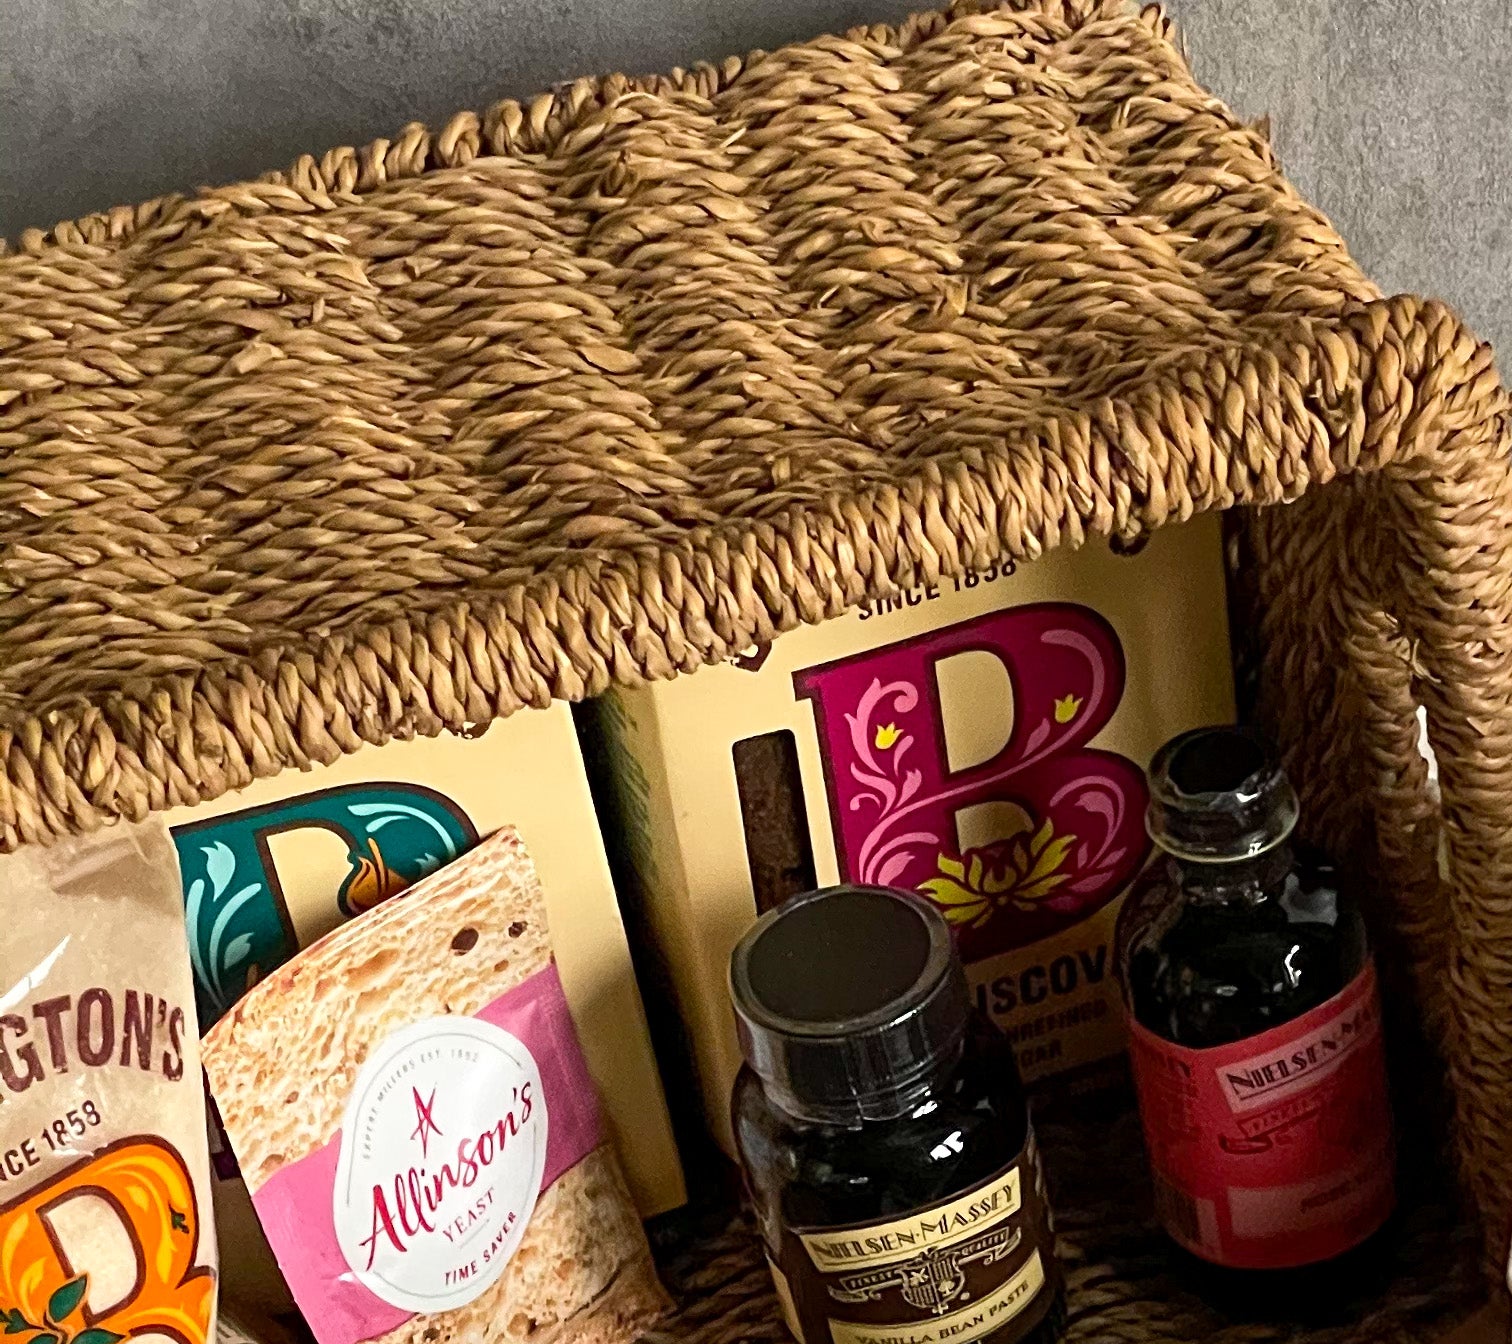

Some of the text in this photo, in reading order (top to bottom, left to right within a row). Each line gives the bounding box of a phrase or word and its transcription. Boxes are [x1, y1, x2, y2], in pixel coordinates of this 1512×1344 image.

[0, 987, 186, 1093] GTON'S
[41, 1099, 101, 1151] 1858
[359, 1081, 533, 1272] Allinson's
[442, 1186, 497, 1243] YEAST
[444, 1210, 517, 1286] TIME SAVER
[938, 1314, 984, 1341] BEAN
[988, 1281, 1029, 1317] PASTE
